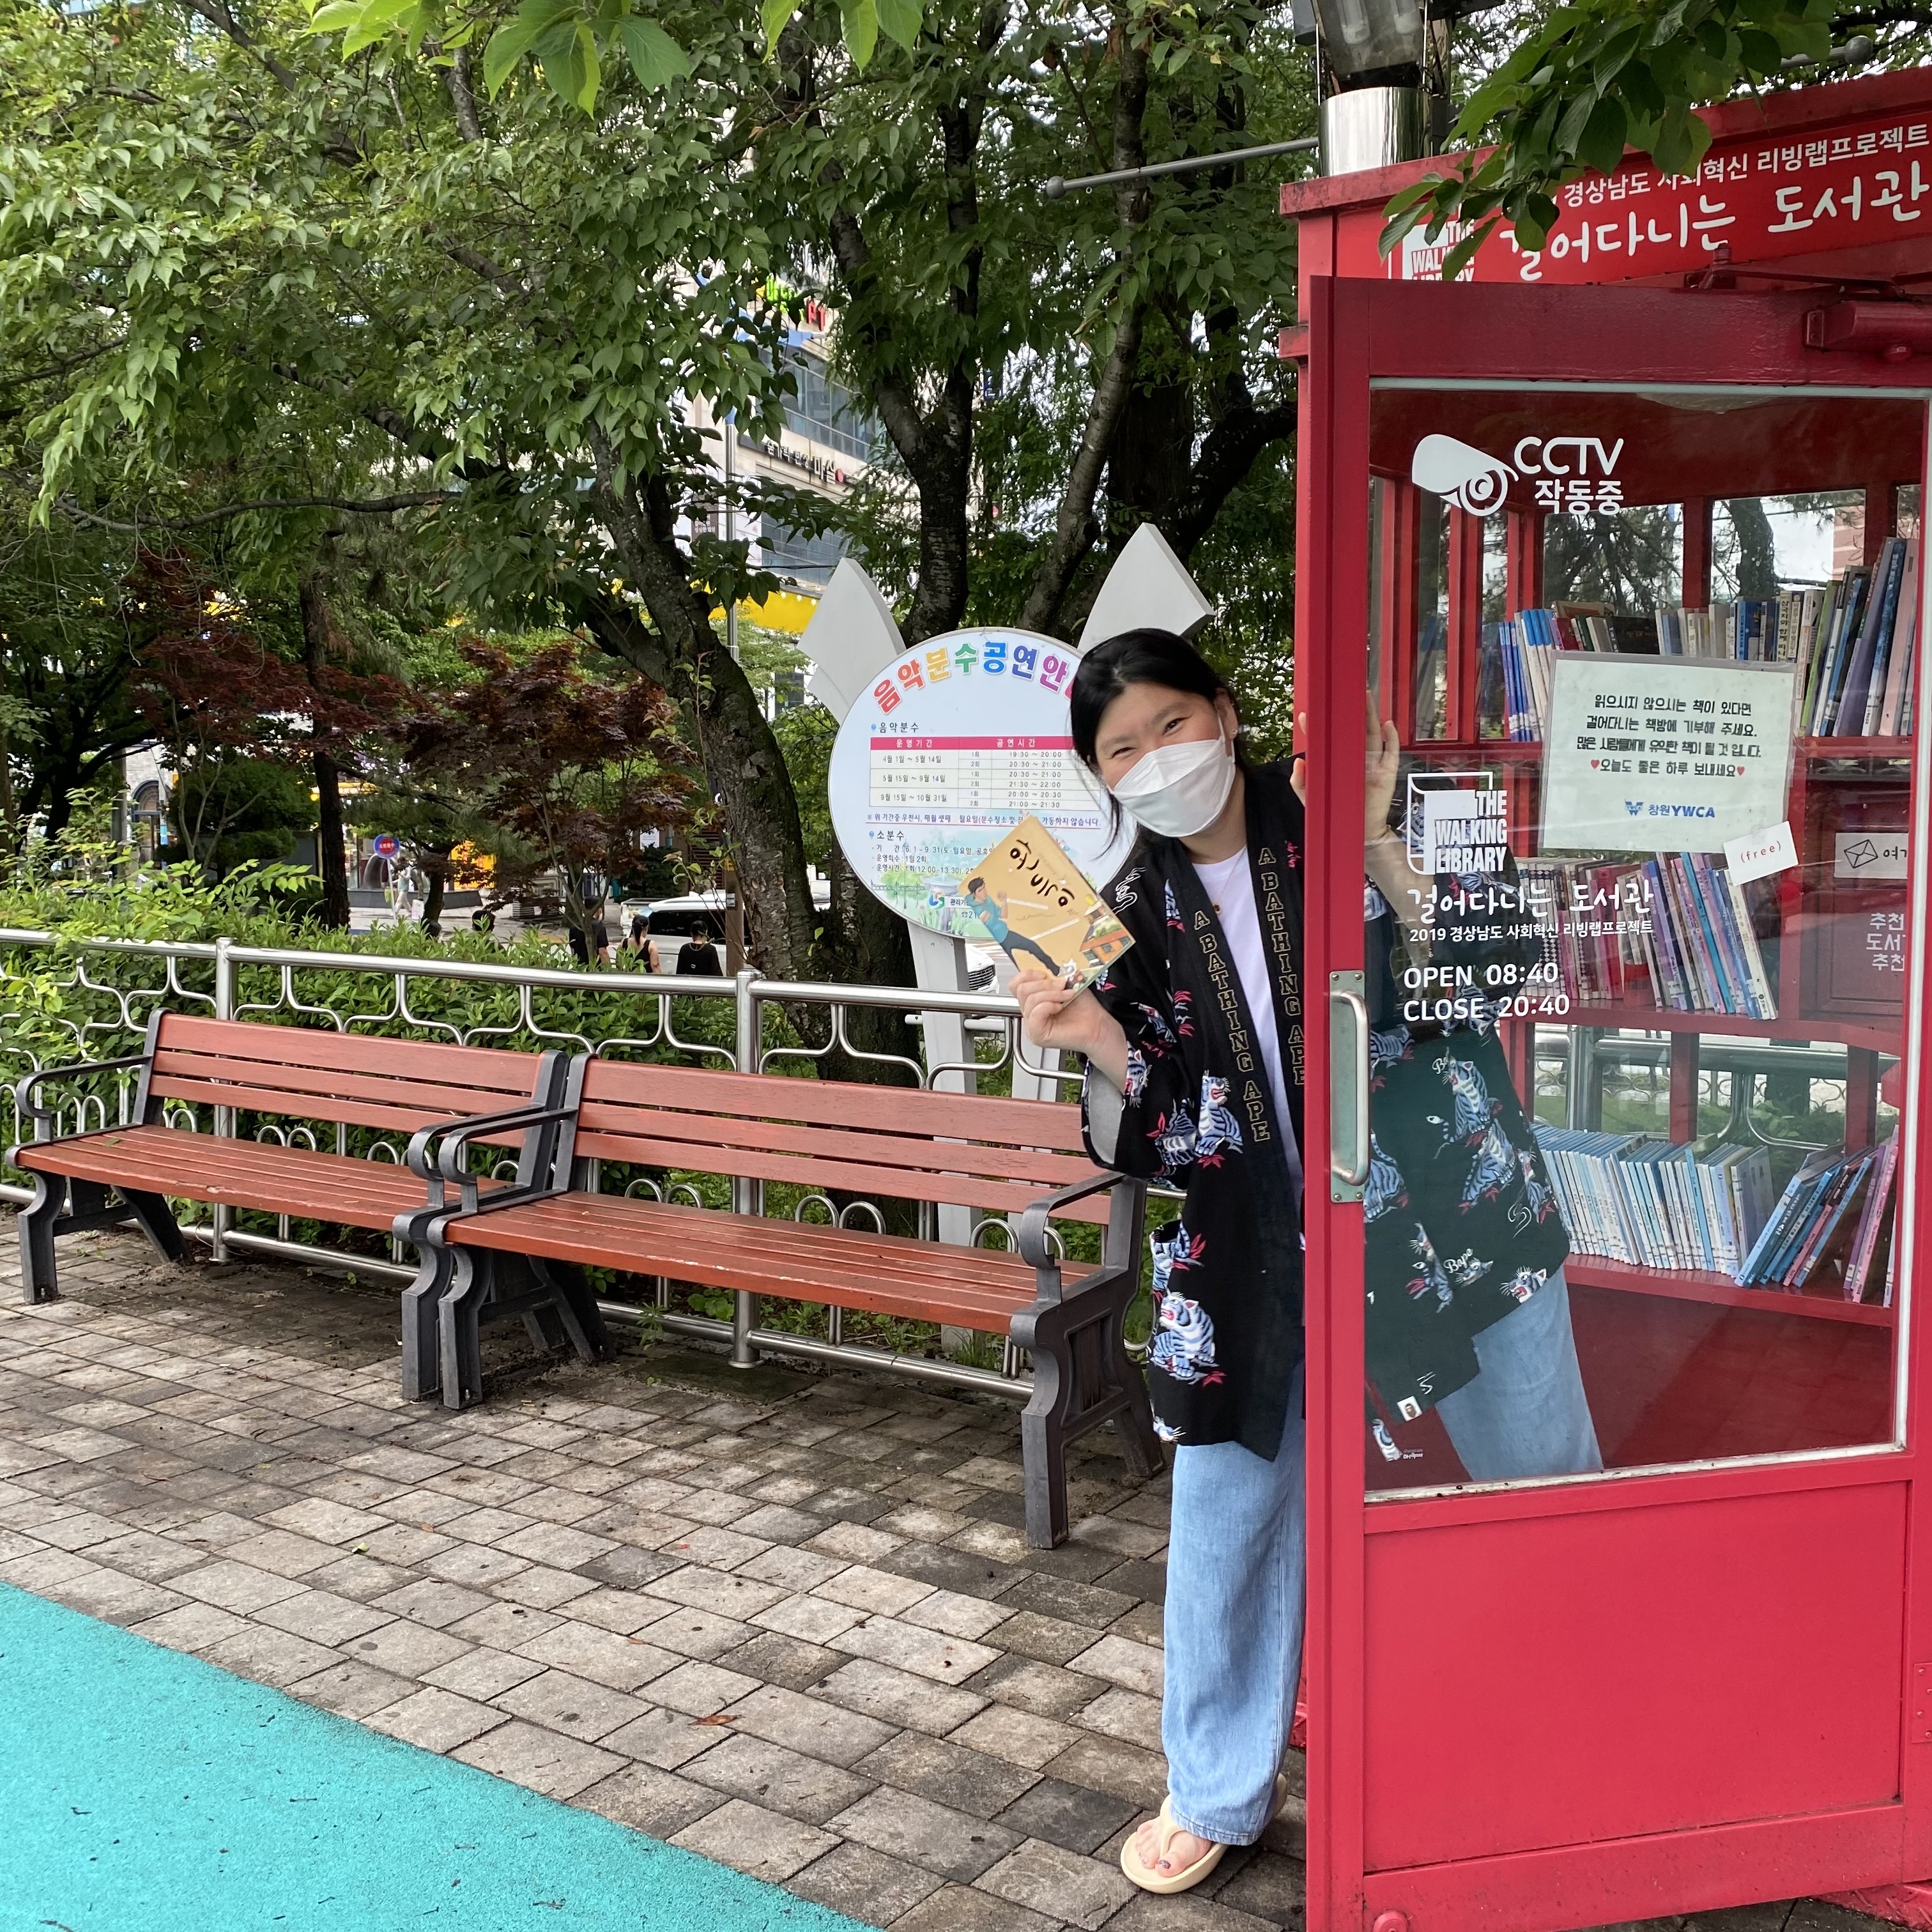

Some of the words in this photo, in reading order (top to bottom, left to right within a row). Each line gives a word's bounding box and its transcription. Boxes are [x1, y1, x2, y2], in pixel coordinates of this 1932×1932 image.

[1564, 172, 1651, 208] 경상남도
[1757, 123, 1930, 175] 리빙랩프로젝트
[1767, 160, 1930, 233] 도서관
[1514, 436, 1624, 475] CCTV
[813, 456, 836, 486] 마실
[1534, 479, 1624, 515] 작동중
[873, 640, 1073, 714] 음악분수공연안
[1595, 694, 1637, 710] 읽으시지
[1643, 697, 1687, 712] 않으시는
[1693, 699, 1715, 714] 책이
[1721, 701, 1752, 716] 있다면
[878, 722, 919, 733] 음악분수
[1587, 716, 1639, 731] 걸어다니는
[1645, 717, 1677, 732] 책방에
[1683, 719, 1715, 734] 기부해
[1721, 722, 1757, 737] 주세요.
[896, 739, 933, 748] 운영기간
[996, 738, 1036, 748] 공연시간
[1577, 736, 1596, 750] 많은
[1600, 737, 1646, 752] 사람들에게
[1682, 741, 1701, 755] 책이
[1719, 742, 1728, 756] 것
[883, 755, 893, 763] 4월
[896, 755, 905, 763] 1일
[915, 755, 925, 763] 5월
[928, 755, 942, 763] 14일
[1600, 758, 1632, 772] 오늘도
[1638, 760, 1660, 774] 좋은
[1666, 760, 1688, 775] 하루
[1694, 762, 1736, 778] 보내세요
[882, 774, 893, 783] 5월
[895, 774, 908, 783] 15일
[919, 774, 930, 783] 9월
[932, 774, 946, 783] 14일
[880, 793, 891, 801] 9월
[893, 793, 906, 802] 15일
[917, 793, 931, 802] 10월
[933, 793, 947, 802] 31일
[1476, 790, 1508, 816] THE
[875, 813, 880, 822] 위
[882, 813, 900, 822] 기간중
[901, 814, 923, 823] 우천시,
[1009, 816, 1015, 825] 및
[1041, 816, 1069, 826] 가동하지
[1648, 804, 1716, 818] 창원YWCA
[877, 830, 905, 841] 소분수
[1434, 818, 1508, 845] WALKING
[1258, 847, 1276, 866] A
[1435, 846, 1508, 874] LIBRARY
[1740, 840, 1782, 863] (free)
[876, 864, 900, 873] 운영시간
[1406, 882, 1552, 924] 걸어다니는
[1569, 878, 1655, 914] 도서관
[1193, 910, 1211, 931] A
[1409, 928, 1446, 942] 2019
[1450, 925, 1504, 942] 경상남도
[1506, 922, 1560, 940] 사회혁신
[1563, 920, 1654, 938] 리빙랩프로젝트
[1869, 912, 1905, 931] 추천
[1262, 871, 1302, 1016] BATHING
[1404, 964, 1473, 988] OPEN
[1486, 962, 1559, 986] 08:40
[1200, 932, 1255, 1073] BATHING
[1404, 997, 1485, 1021] CLOSE
[1498, 993, 1570, 1018] 20:40
[1243, 1080, 1271, 1143] APE
